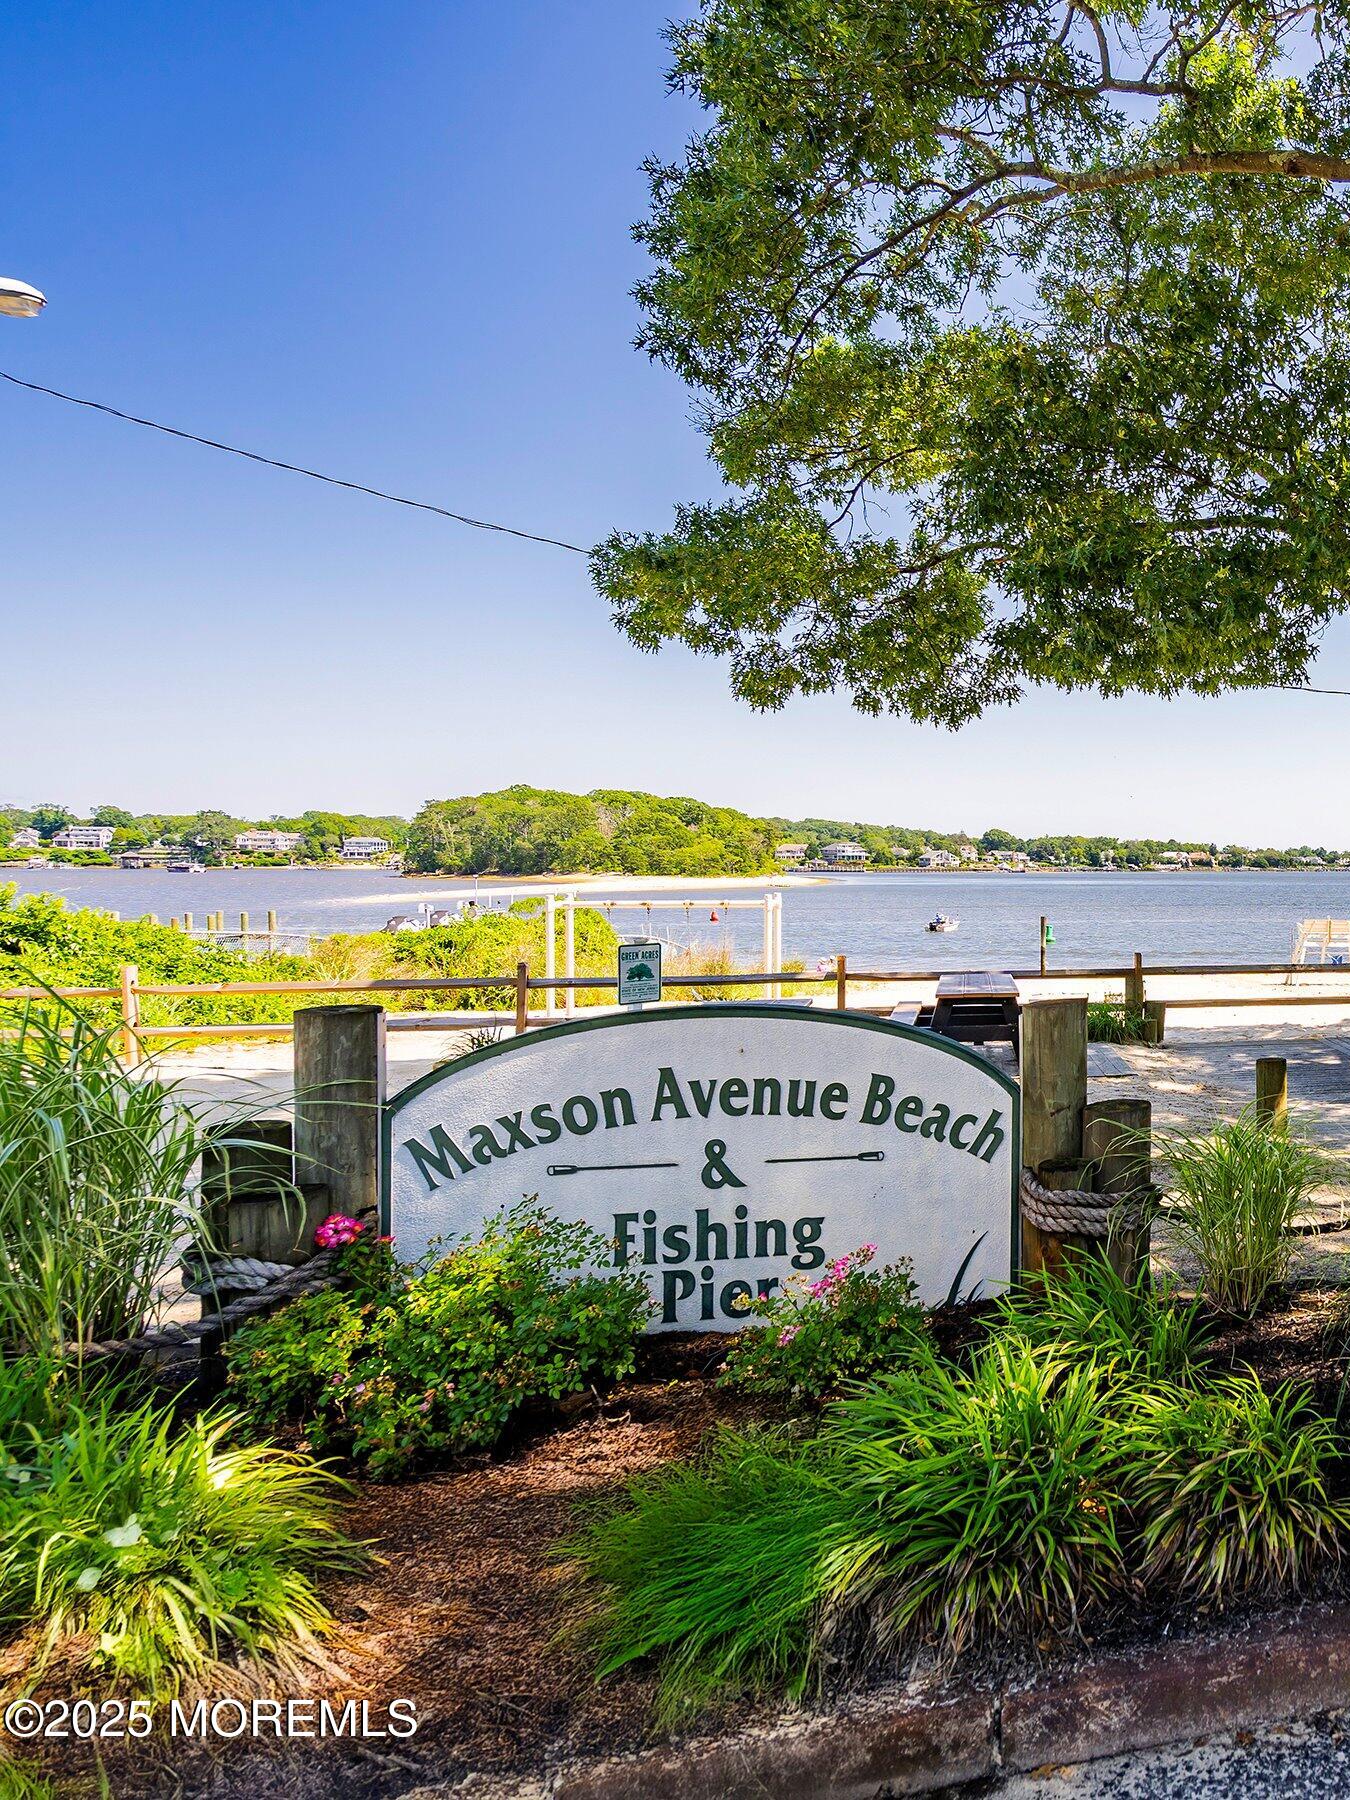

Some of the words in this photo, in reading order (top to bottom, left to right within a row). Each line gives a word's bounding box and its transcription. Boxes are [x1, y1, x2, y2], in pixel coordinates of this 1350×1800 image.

[621, 951, 640, 961] GREEN
[641, 950, 659, 960] ACRES
[402, 1087, 638, 1192] Maxson
[650, 1066, 849, 1122] Avenue
[858, 1072, 1006, 1164] Beach
[700, 1138, 748, 1190] &
[612, 1204, 826, 1270] Fishing
[660, 1265, 779, 1324] Pier
